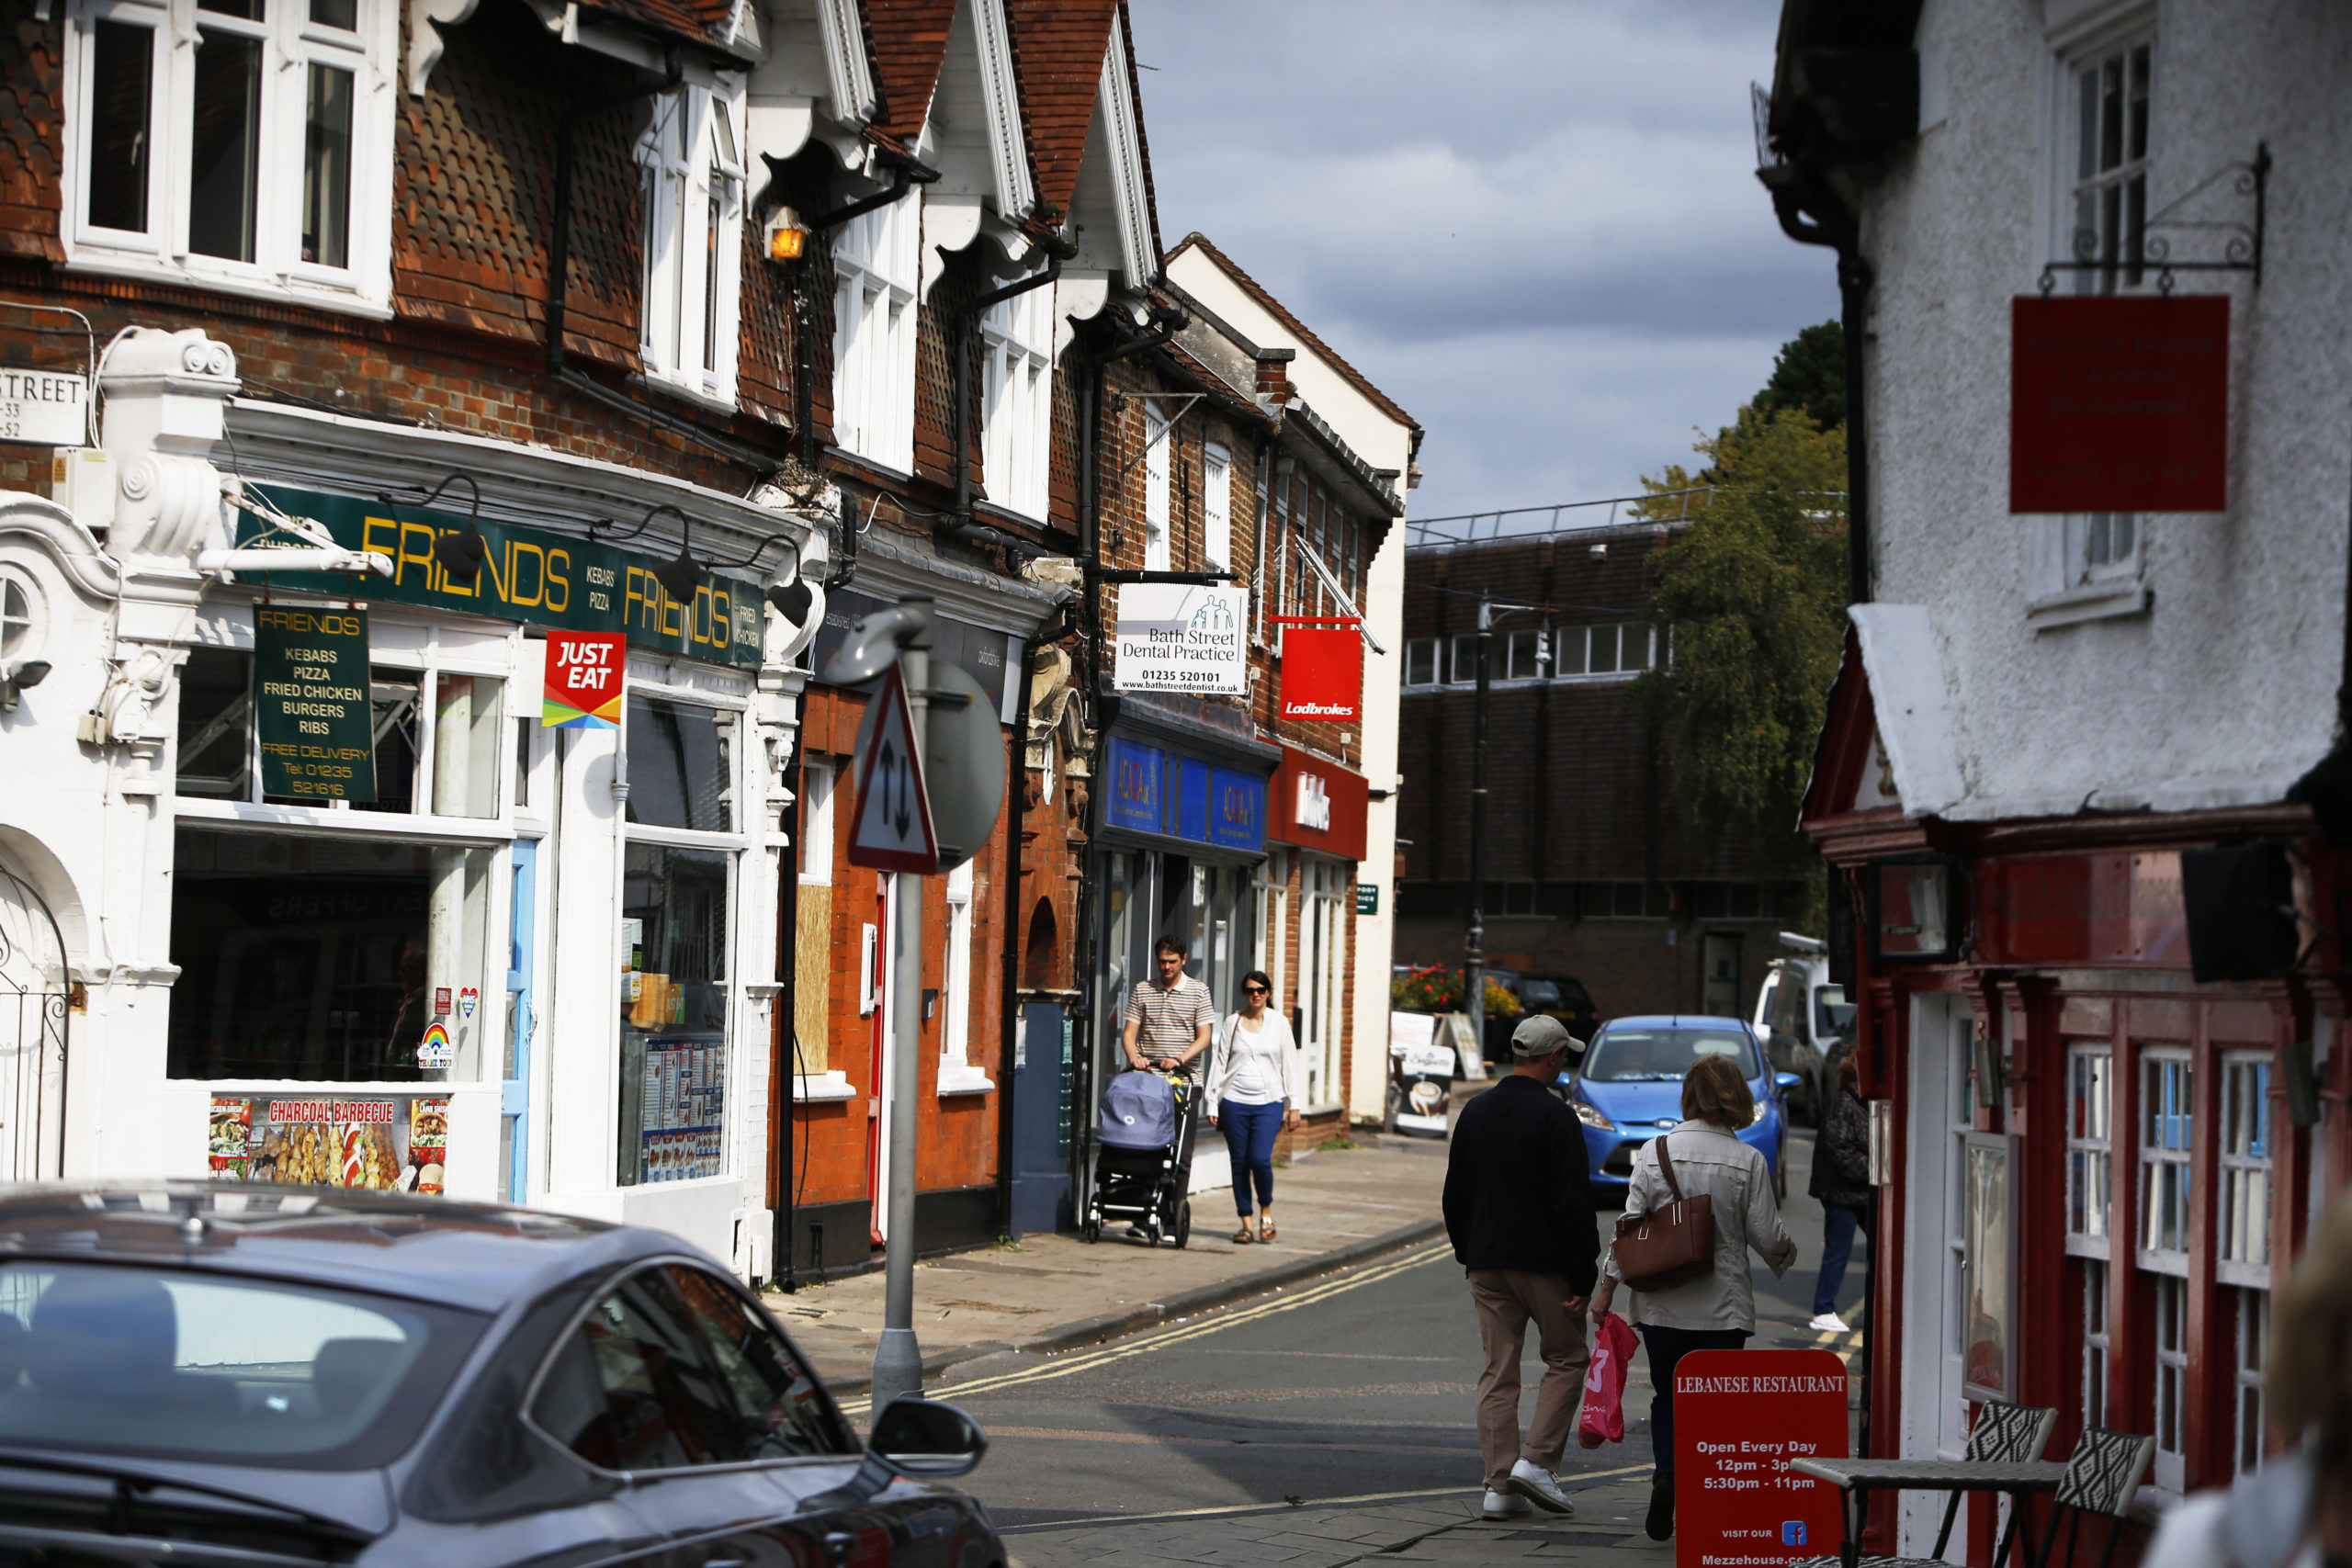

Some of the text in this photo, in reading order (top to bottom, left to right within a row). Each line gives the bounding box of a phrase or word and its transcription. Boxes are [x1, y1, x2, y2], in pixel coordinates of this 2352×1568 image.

[0, 373, 81, 403] TREET
[586, 566, 615, 588] KEBABS
[589, 592, 610, 612] PIZZA
[624, 566, 730, 649] FRIENDS
[259, 611, 360, 636] FRIENDS
[740, 605, 756, 625] FRIED
[736, 628, 759, 648] CHICKEN
[1149, 628, 1235, 646] Bath Street
[285, 648, 337, 663] KEBABS
[557, 642, 614, 668] JUST
[1124, 643, 1235, 661] Dental Practice
[293, 667, 331, 682] PIZZA
[567, 666, 612, 690] EAT
[1142, 670, 1220, 682] 01235 520101
[264, 682, 363, 702] FRIED CHICKEN
[1122, 681, 1238, 693] www.bathstreetdentist.co.uk
[282, 702, 345, 718] BURGERS
[1285, 702, 1353, 716] Ladbrokes
[300, 721, 330, 735] RIBS
[262, 743, 370, 761] FREE DELIVERY
[306, 764, 353, 779] 01235
[293, 781, 345, 796] 521616
[269, 1100, 393, 1122] CHARCOAL BARBECUE
[1677, 1376, 1845, 1393] LEBANESE RESTAURANT
[1697, 1441, 1816, 1455] Open Every Day
[1716, 1460, 1757, 1472] 12pm
[1771, 1460, 1792, 1472] 3p
[1704, 1478, 1759, 1491] 5:30pm
[1774, 1477, 1815, 1491] 11pm
[1722, 1530, 1748, 1539] VISIT
[1750, 1530, 1772, 1539] OUR
